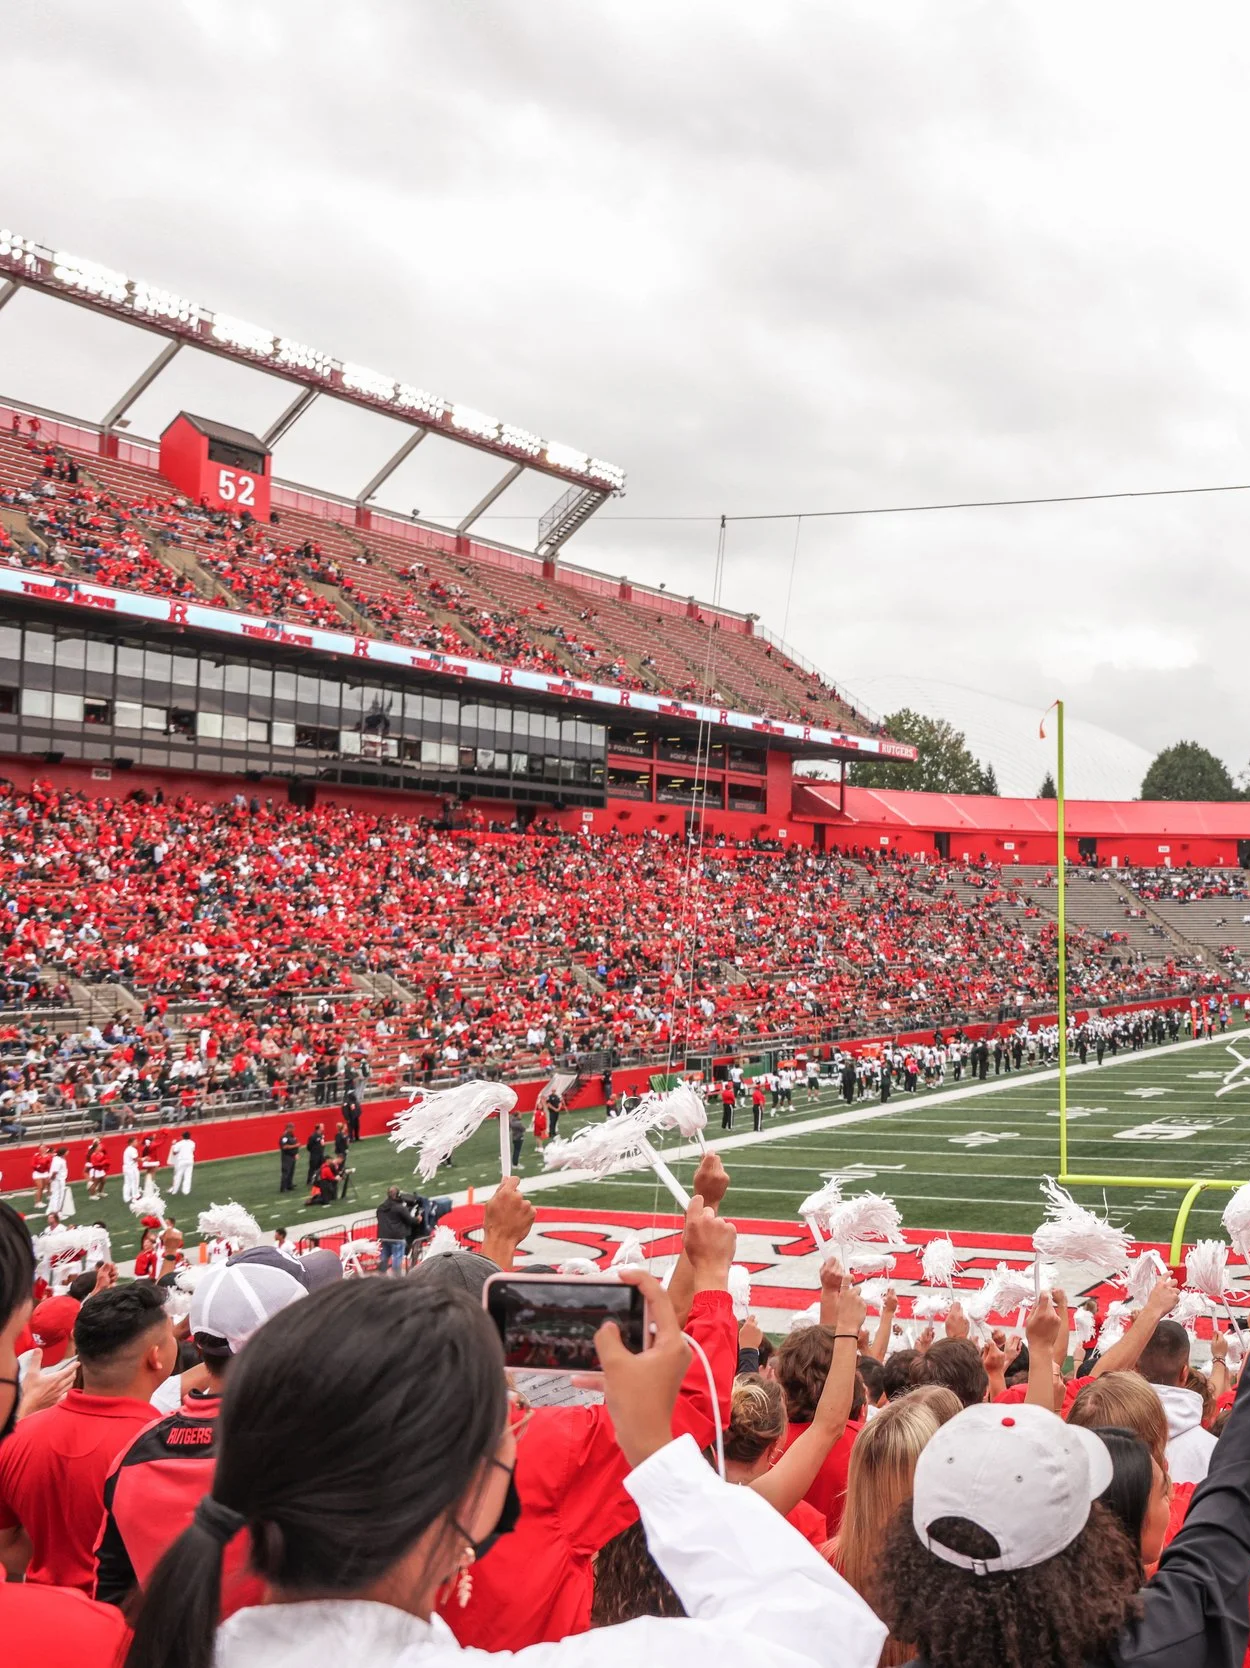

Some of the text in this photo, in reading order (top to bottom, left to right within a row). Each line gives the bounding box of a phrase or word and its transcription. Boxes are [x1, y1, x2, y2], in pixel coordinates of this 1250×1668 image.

[218, 469, 256, 507] 52
[168, 602, 190, 625] R
[353, 638, 370, 658] R
[500, 666, 513, 685] R
[881, 743, 914, 758] RUTGERS
[166, 1427, 214, 1445] RUTGERS
